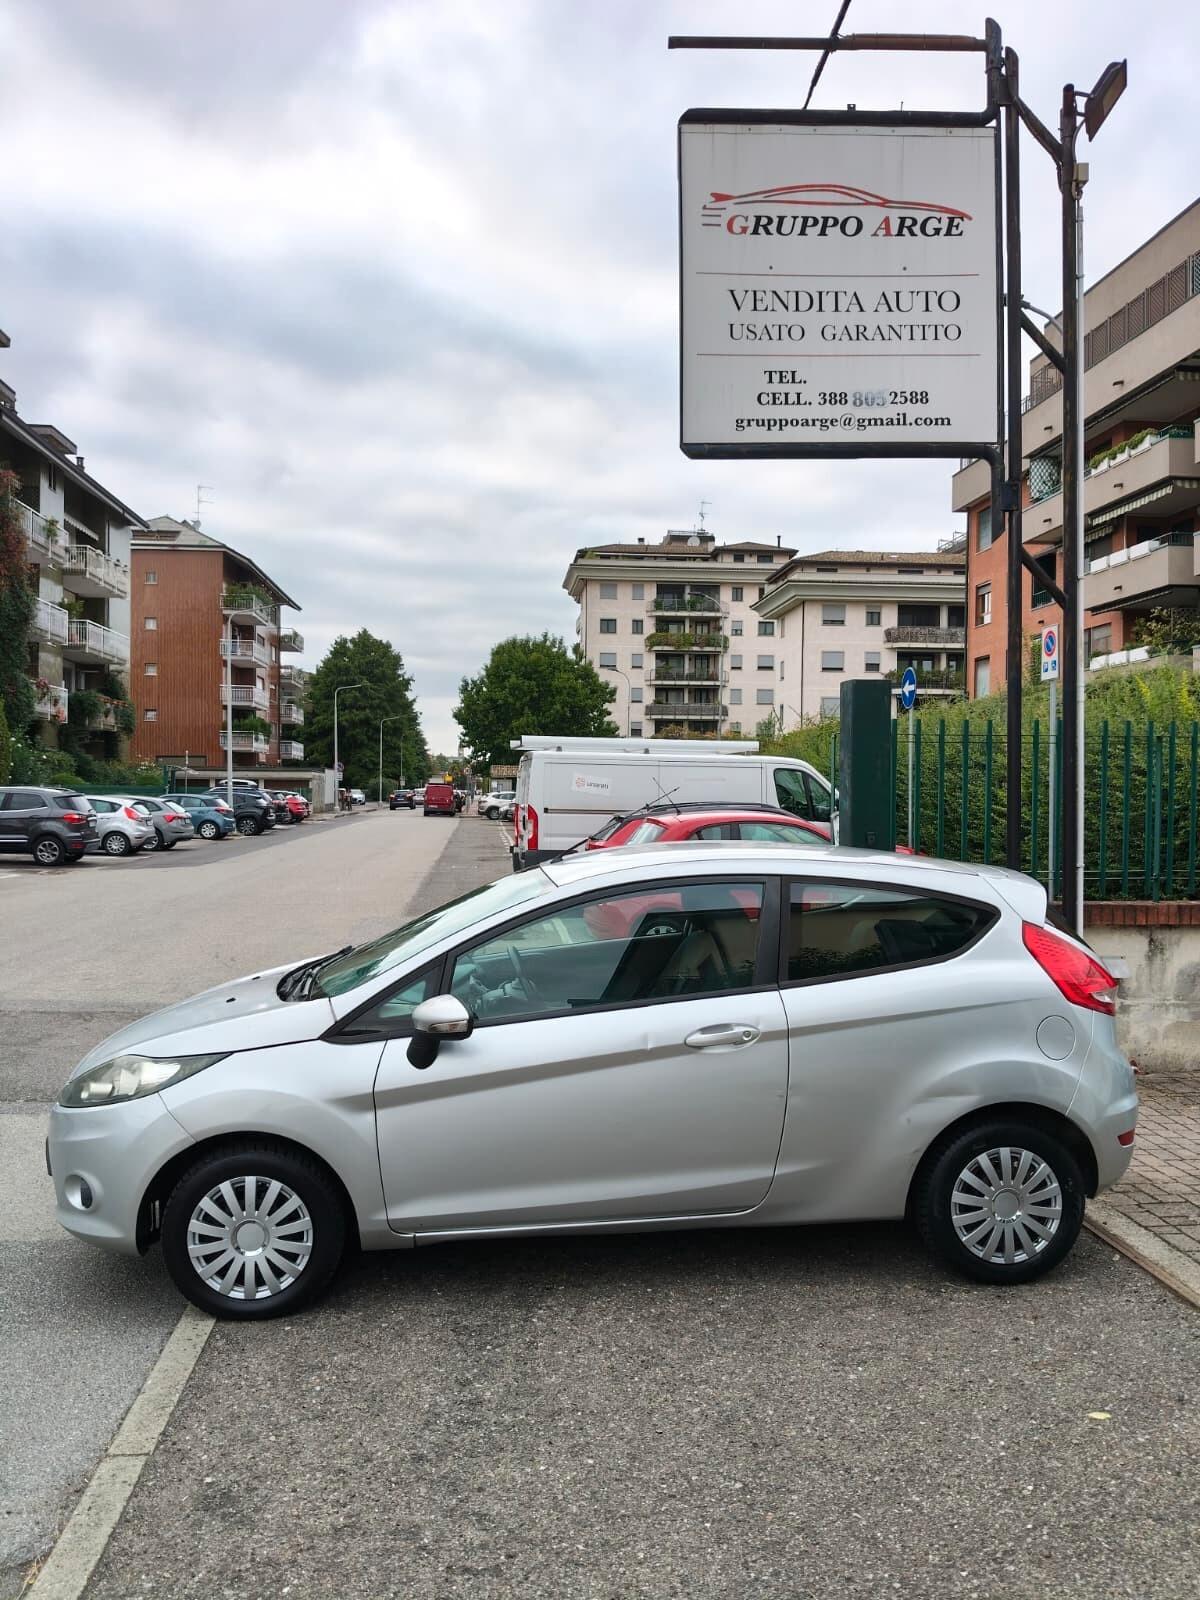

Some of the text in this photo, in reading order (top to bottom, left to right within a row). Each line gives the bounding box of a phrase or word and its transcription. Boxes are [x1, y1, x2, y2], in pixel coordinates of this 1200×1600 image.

[726, 215, 964, 237] GRUPPO ARGE
[728, 289, 961, 313] VENDITA AUTO
[728, 323, 962, 342] USATO GARANTITO
[764, 370, 807, 384] TEL.
[756, 392, 812, 406] CELL.
[818, 392, 848, 406] 388
[889, 391, 929, 405] 2588
[735, 412, 952, 431] gruppoarge@gmail.com
